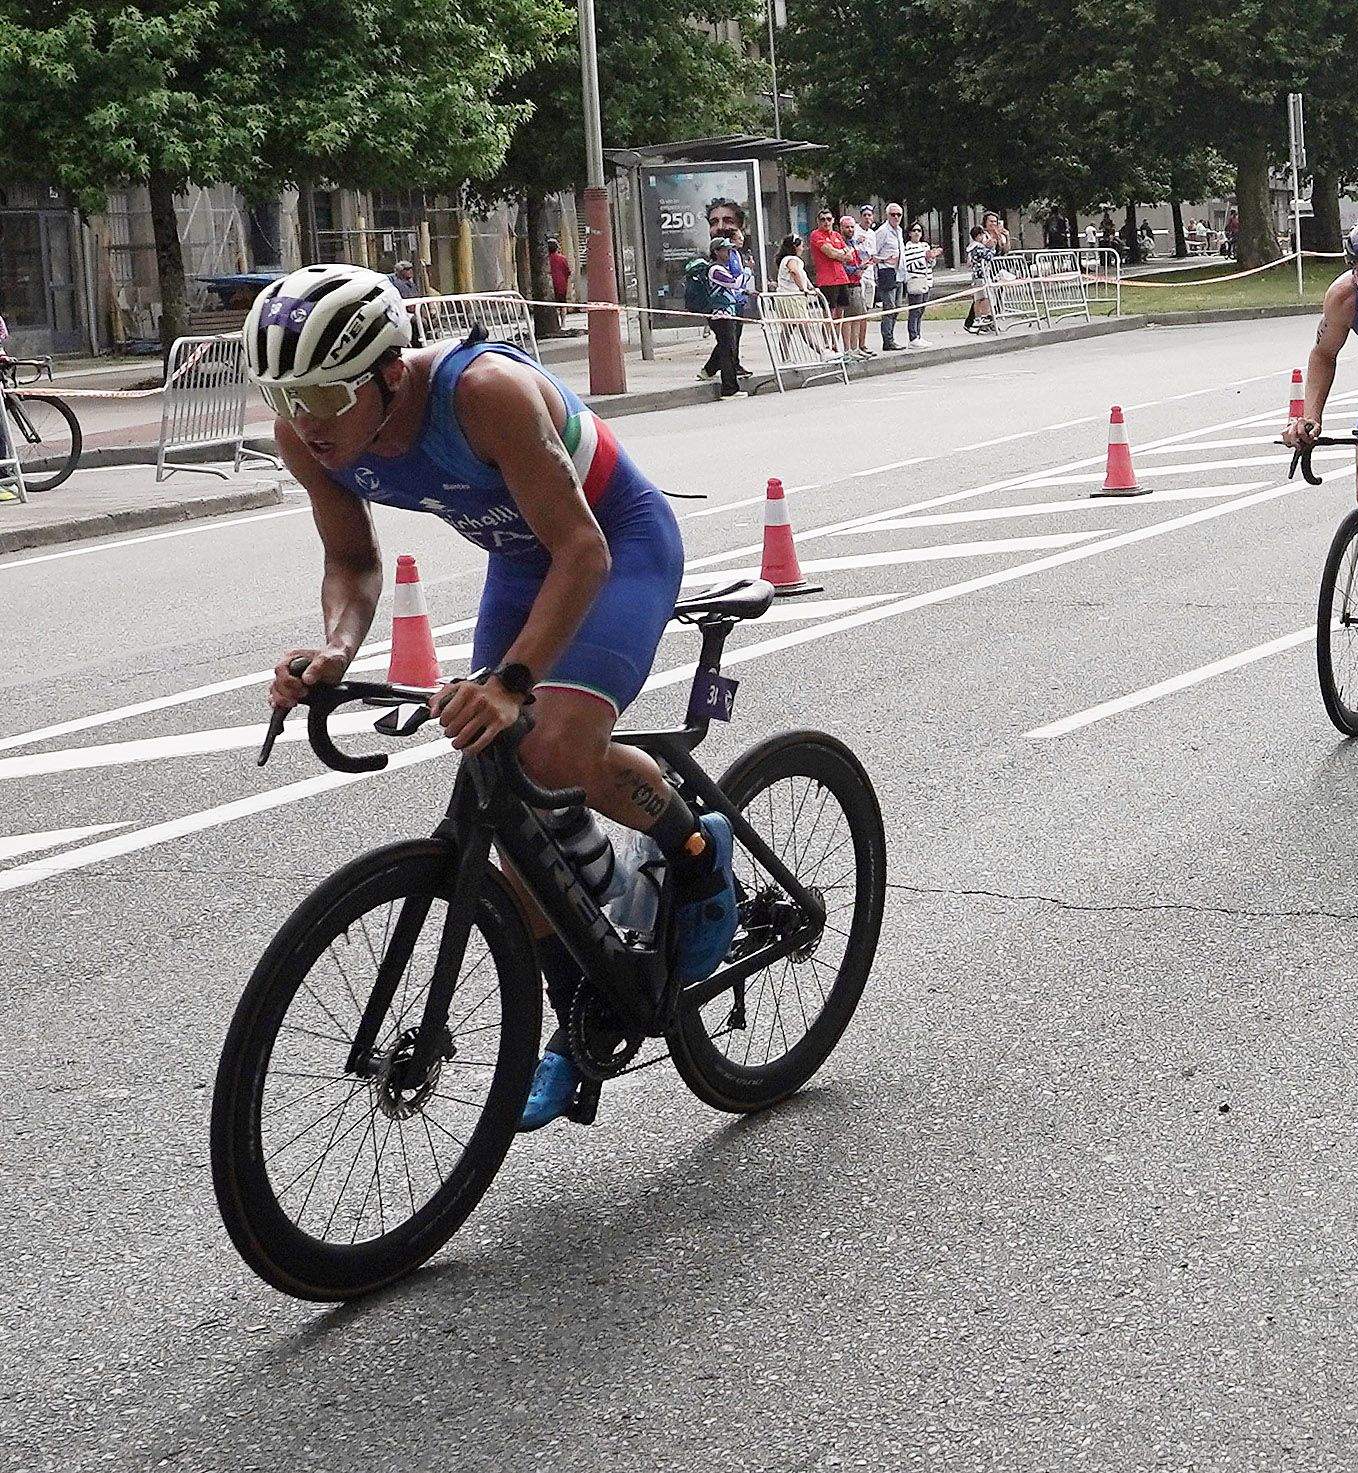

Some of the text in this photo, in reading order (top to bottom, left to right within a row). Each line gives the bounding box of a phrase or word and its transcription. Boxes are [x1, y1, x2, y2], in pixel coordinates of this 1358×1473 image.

[660, 211, 695, 229] 250
[328, 310, 367, 361] MET
[706, 685, 718, 706] 31
